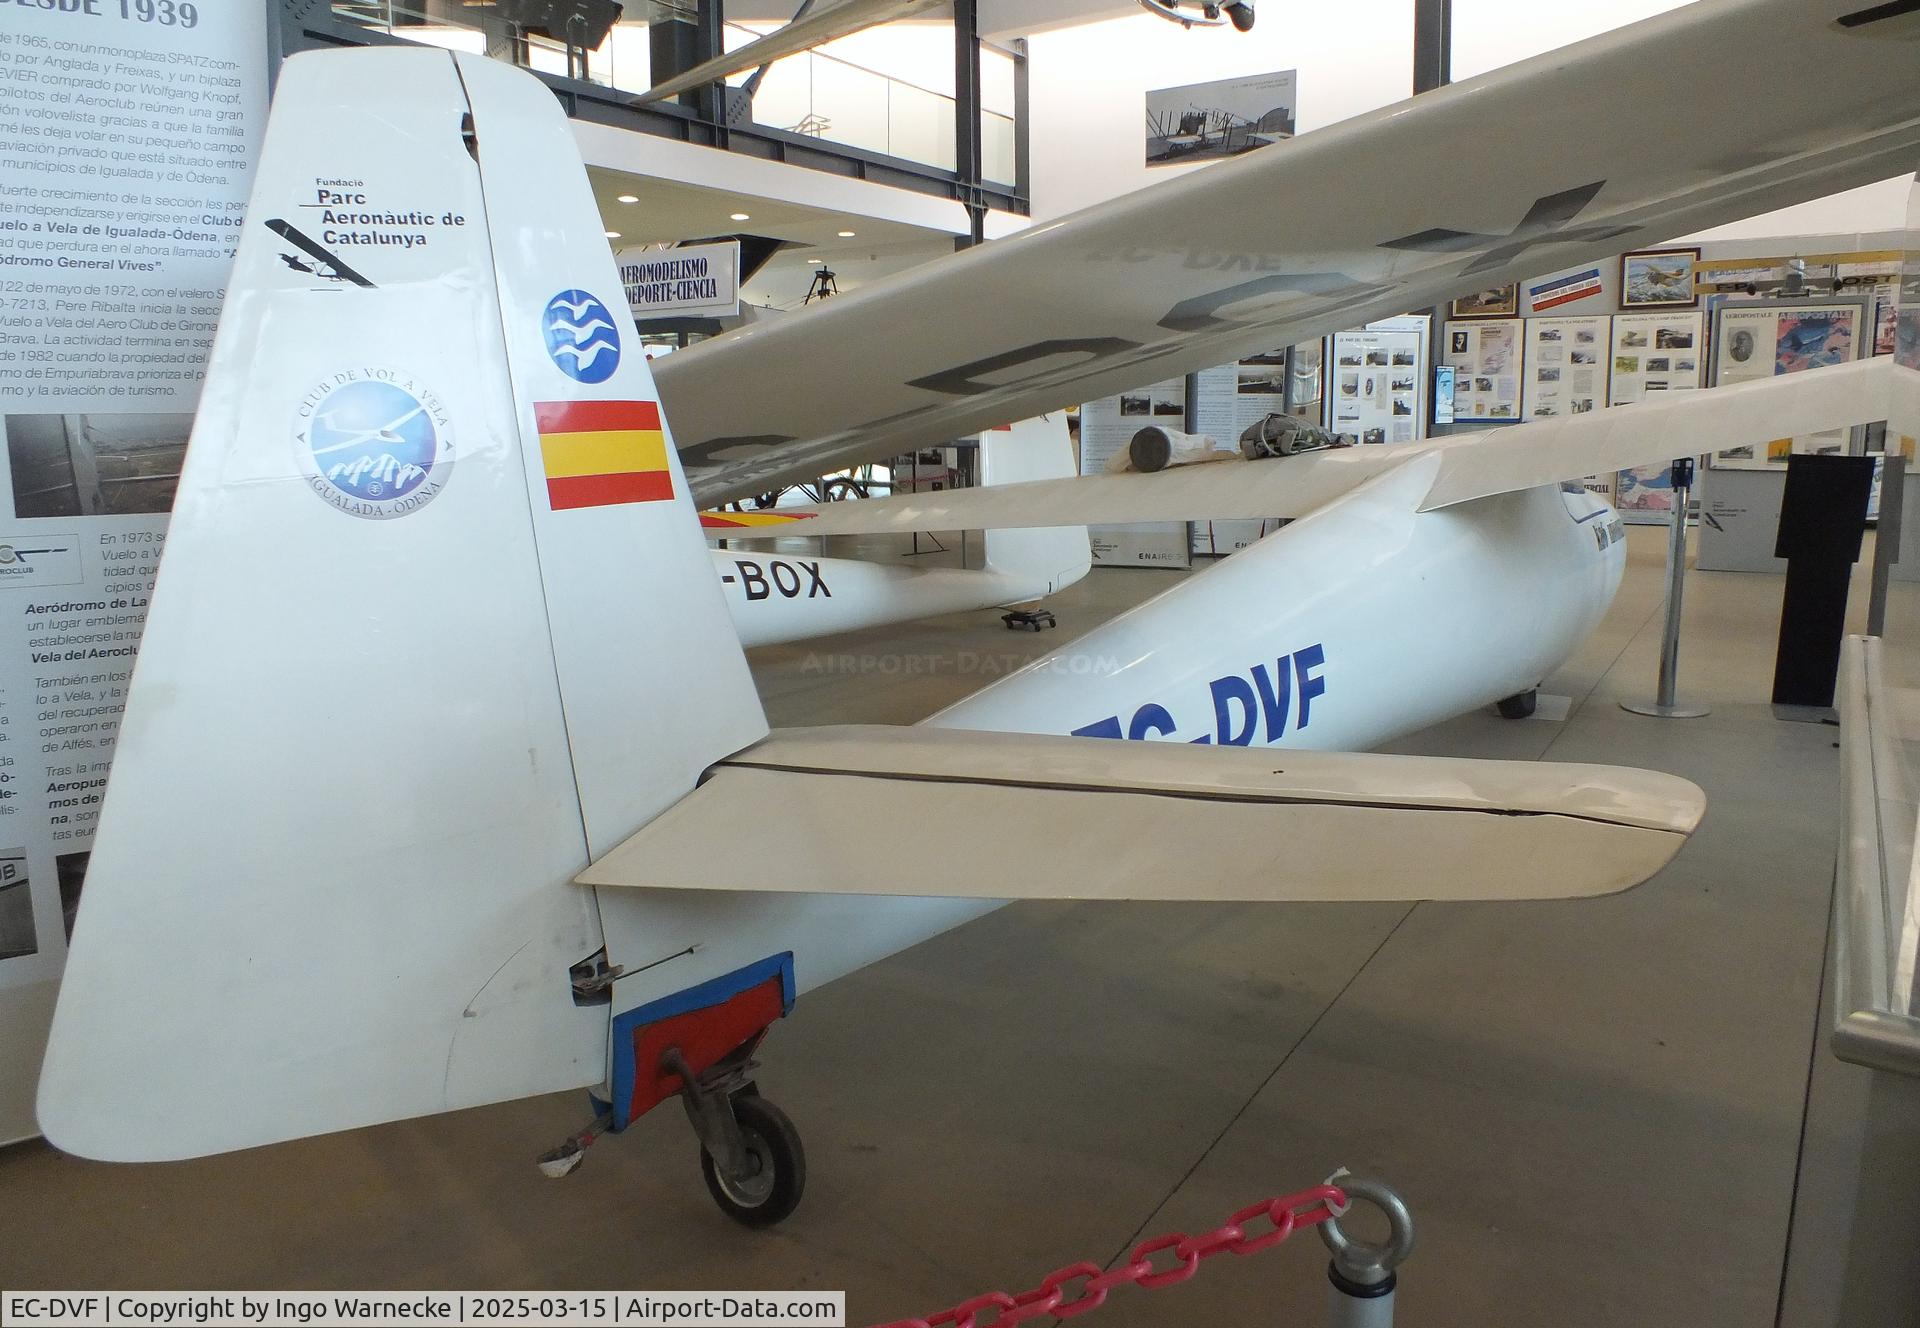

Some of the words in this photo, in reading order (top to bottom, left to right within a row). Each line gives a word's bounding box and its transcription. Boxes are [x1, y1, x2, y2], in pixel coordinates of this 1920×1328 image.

[54, 41, 78, 51] con
[98, 46, 166, 63] monoplaza
[166, 52, 210, 67] SPATZ
[209, 60, 240, 70] com-
[14, 54, 38, 64] por
[42, 55, 98, 71] Anglada
[199, 73, 240, 87] biplaza
[40, 74, 111, 90] comprado
[113, 82, 136, 93] por
[140, 82, 198, 102] Wolfgang
[49, 91, 70, 103] del
[74, 93, 134, 109] Aeroclub
[140, 101, 184, 114] reúnen
[188, 107, 212, 118] una
[215, 110, 242, 121] gran
[24, 107, 95, 123] volovelista
[99, 115, 147, 128] gracias
[163, 121, 187, 132] que
[206, 124, 243, 136] familia
[20, 123, 40, 135] les
[43, 126, 71, 140] deja
[74, 129, 106, 141] volar
[144, 137, 200, 150] pequeño
[203, 142, 244, 154] campo
[57, 144, 107, 158] privado
[110, 150, 135, 161] que
[138, 152, 165, 163] está
[168, 153, 213, 167] situado
[216, 159, 246, 169] entre
[2, 159, 75, 173] municipios
[99, 164, 153, 179] Igualada
[316, 178, 364, 187] Fundació
[40, 189, 118, 202] crecimiento
[154, 196, 202, 208] sección
[205, 198, 222, 209] les
[225, 202, 248, 212] per-
[318, 189, 367, 205] Parc
[14, 202, 114, 219] independizarse
[125, 210, 172, 224] erigirse
[202, 214, 232, 226] Club
[322, 210, 435, 226] Aeronàutic
[442, 212, 465, 226] de
[47, 221, 77, 233] Vela
[323, 230, 427, 248] Catalunya
[17, 239, 43, 250] que
[45, 240, 98, 252] perdura
[133, 244, 169, 255] ahora
[172, 246, 220, 258] llamado
[57, 256, 114, 268] General
[45, 284, 81, 296] mayo
[140, 288, 164, 297] con
[178, 288, 214, 298] velero
[55, 299, 87, 311] Pere
[90, 300, 135, 312] Ribalta
[140, 302, 171, 314] inicia
[45, 316, 72, 328] Vela
[74, 317, 94, 328] del
[96, 318, 126, 328] Aero
[128, 318, 158, 330] Club
[178, 319, 217, 331] Girona
[62, 334, 122, 345] actividad
[124, 336, 171, 346] termina
[20, 350, 52, 361] 1982
[55, 351, 106, 362] cuando
[120, 352, 185, 366] propiedad
[186, 351, 206, 364] del
[44, 367, 134, 380] Empuriabrava
[136, 368, 182, 381] prioriza
[52, 384, 104, 395] aviación
[299, 383, 331, 418] CLUB
[334, 370, 357, 385] DE
[364, 368, 399, 383] VOL
[403, 380, 414, 391] A
[421, 390, 448, 426] VELA
[311, 474, 384, 516] IGUALADA
[122, 532, 152, 542] 1973
[102, 549, 136, 560] Vuelo
[104, 564, 135, 576] tidad
[104, 581, 142, 594] cipios
[24, 601, 105, 614] Aeródromo
[48, 619, 81, 631] lugar
[28, 633, 110, 647] establecerse
[32, 651, 61, 662] Vela
[64, 649, 86, 660] del
[35, 673, 88, 688] También
[108, 671, 127, 681] los
[37, 709, 57, 720] del
[40, 722, 97, 738] operaron
[45, 766, 71, 776] Tras
[46, 778, 106, 792] Aeropue
[48, 798, 78, 808] mos
[74, 810, 99, 821] son
[52, 830, 71, 839] tas
